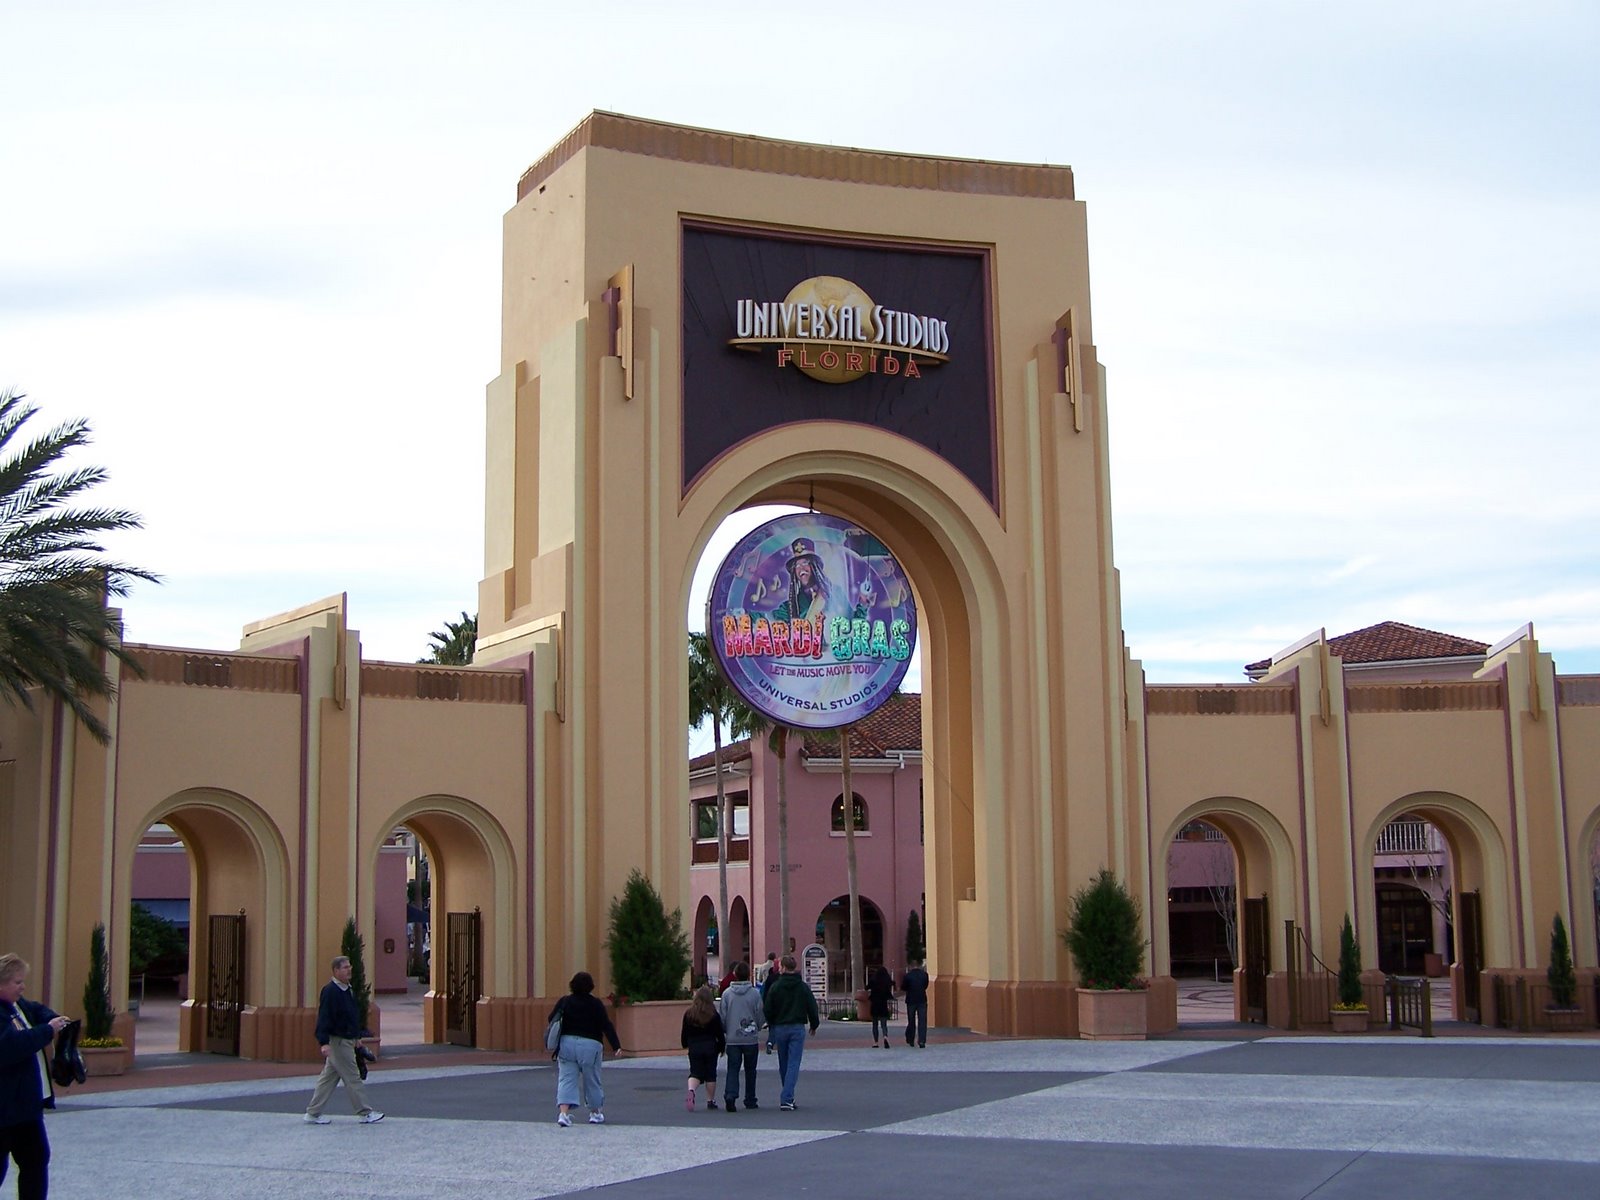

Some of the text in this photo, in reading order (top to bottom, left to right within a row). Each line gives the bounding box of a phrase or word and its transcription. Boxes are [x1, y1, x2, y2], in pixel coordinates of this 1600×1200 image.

[737, 299, 949, 354] UNIVERSAL STUDIOS
[777, 349, 921, 378] FLORIDA
[722, 611, 911, 661] MARDI GRAS
[769, 664, 786, 676] LET
[796, 667, 825, 678] MUSIC
[825, 665, 852, 677] MOVE
[853, 664, 871, 675] YOU
[758, 679, 879, 711] UNIVERSAL STUDIOS
